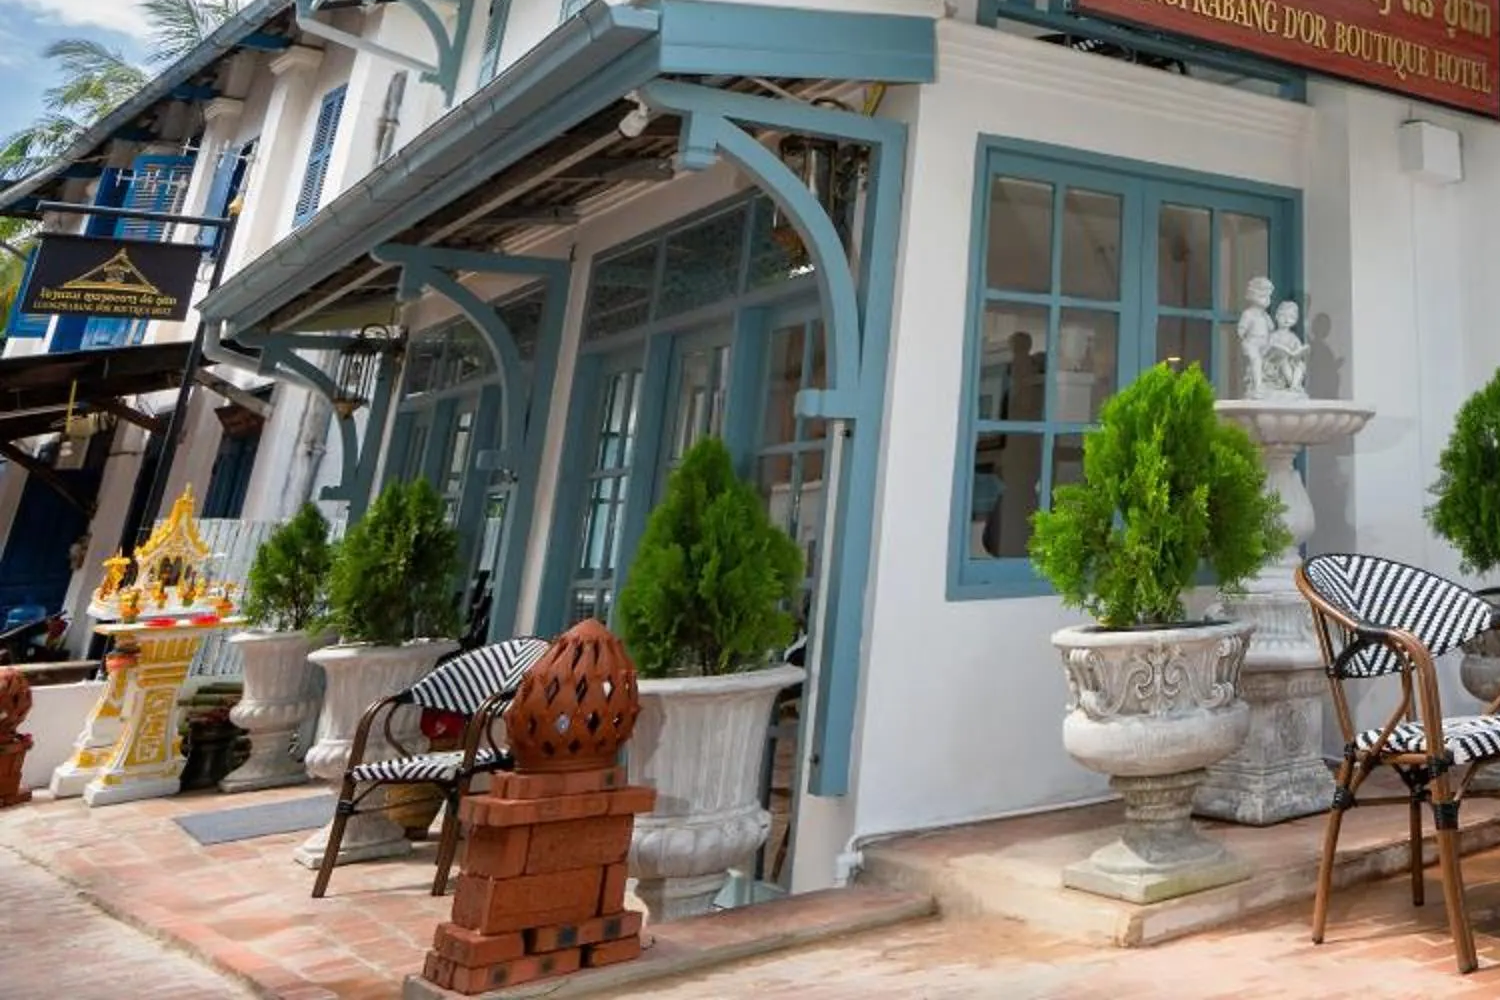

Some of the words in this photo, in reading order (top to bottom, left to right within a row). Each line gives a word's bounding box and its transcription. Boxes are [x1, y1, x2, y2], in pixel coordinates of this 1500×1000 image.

[1283, 5, 1329, 49] D'OR
[1335, 21, 1429, 81] BOUTIQUE
[1434, 51, 1491, 93] HOTEL
